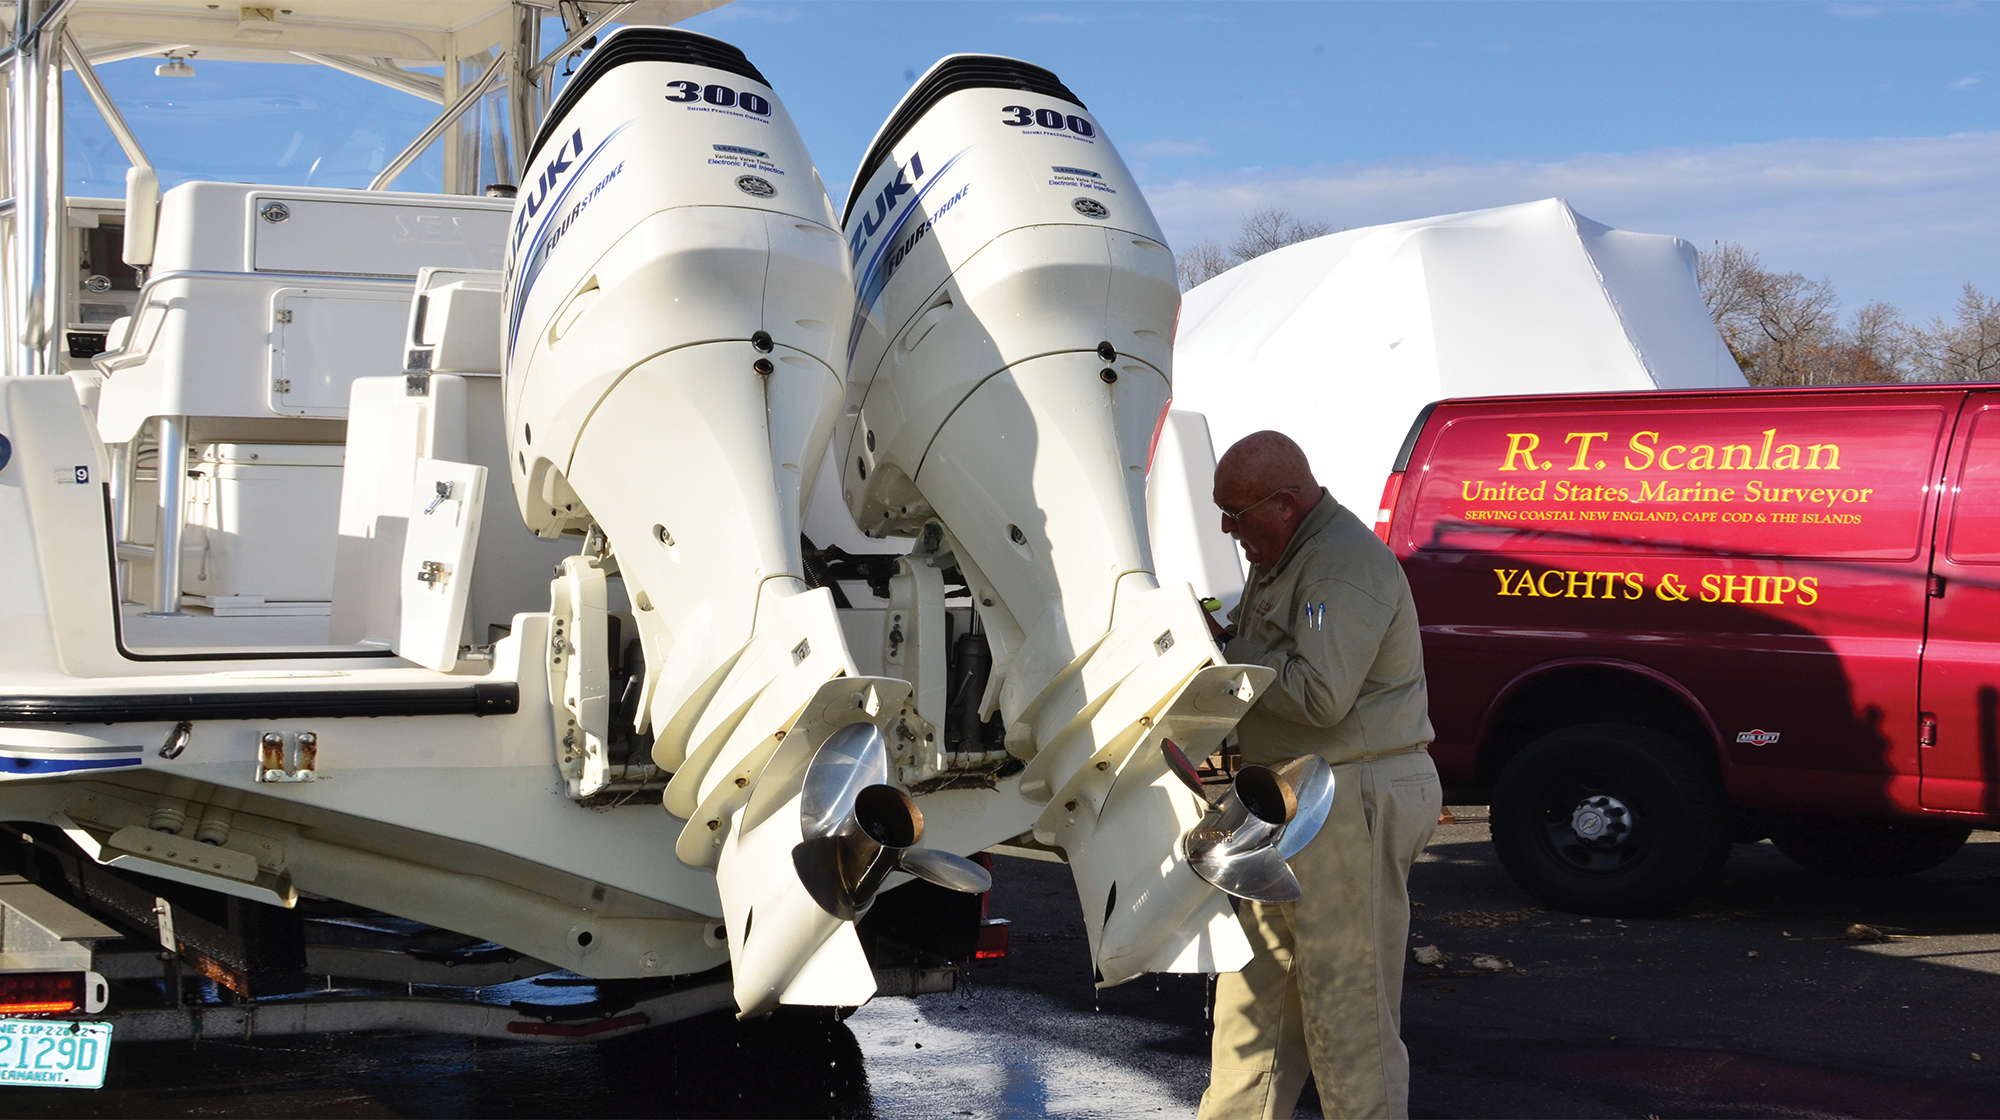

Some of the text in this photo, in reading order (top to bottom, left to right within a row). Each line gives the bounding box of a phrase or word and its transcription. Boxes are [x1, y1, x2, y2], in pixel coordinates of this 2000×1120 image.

[665, 80, 772, 117] 300
[711, 108, 744, 117] Precision
[745, 114, 769, 124] Control
[1001, 105, 1096, 139] 300
[1043, 131, 1072, 139] Precision
[1072, 136, 1094, 144] Control
[708, 159, 741, 167] Electronic
[758, 164, 785, 175] Injection
[756, 159, 775, 167] Timing
[1091, 179, 1107, 187] Timing
[1094, 184, 1117, 194] Injection
[545, 160, 625, 260] FOURSTROKE
[850, 151, 924, 271] ZUKI
[887, 183, 970, 278] FOURSTROKE
[1499, 428, 1841, 471] R. T. Scanlan
[76, 468, 88, 481] 9
[1462, 480, 1874, 508] United States Marine Surveyor
[1465, 510, 1862, 525] SERVING COASTAL NEW ENGLAND, CAPE COD & THE ISLANDS
[1494, 569, 1818, 606] YACHTS & SHIPS
[0, 1070, 63, 1082] ERMANENT
